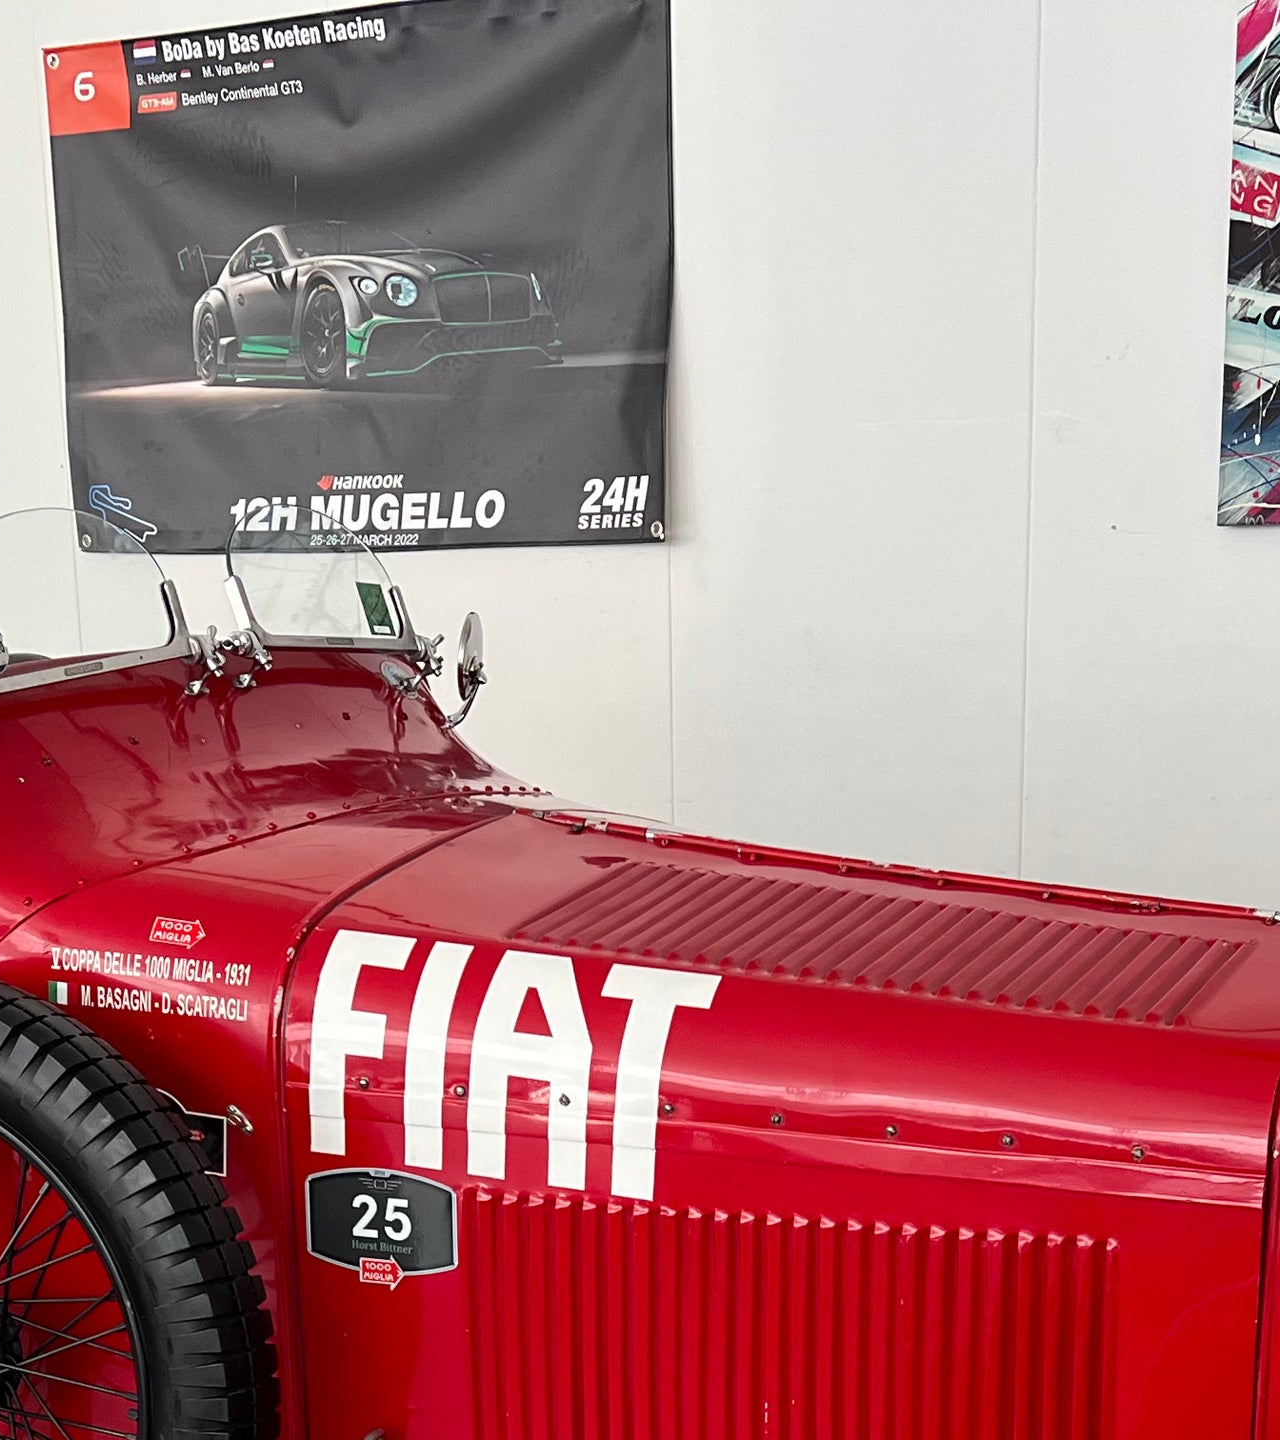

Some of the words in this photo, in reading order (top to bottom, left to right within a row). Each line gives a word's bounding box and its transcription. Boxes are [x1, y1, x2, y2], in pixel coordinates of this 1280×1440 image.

[161, 40, 203, 62] BoDa
[206, 38, 226, 61] by
[228, 30, 260, 53] Bas
[263, 24, 321, 49] Koeten
[323, 17, 386, 42] Racing
[73, 71, 96, 102] 6
[136, 74, 146, 86] B.
[148, 70, 177, 85] Herber
[202, 66, 213, 78] M.
[215, 64, 233, 77] Van
[235, 61, 260, 75] Berlo
[181, 90, 219, 108] Bentley
[220, 83, 278, 103] Continental
[280, 80, 303, 96] GT3
[579, 475, 649, 513] 24H
[229, 495, 297, 531] 12H
[310, 490, 506, 532] MUGELLO
[578, 512, 644, 530] SERIES
[310, 534, 352, 546] 25-26-27
[353, 533, 393, 546] MARCH
[394, 533, 419, 546] 2022
[153, 930, 192, 944] MIGLIA
[160, 920, 193, 933] 1000
[51, 947, 62, 970] V
[62, 948, 101, 974] COPPA
[103, 952, 142, 977] DELLE
[145, 955, 171, 979] 1000
[172, 958, 214, 983] MIGLIA
[224, 963, 251, 986] 1931
[81, 984, 94, 1008] M.
[97, 986, 152, 1013] BASAGNI
[161, 992, 174, 1015] D.
[177, 993, 248, 1021] SCATRAGLI
[309, 929, 722, 1201] FIAT
[352, 1194, 412, 1241] 25
[352, 1239, 377, 1251] Horst
[380, 1242, 413, 1254] Bittner
[363, 1271, 394, 1282] MIGLIA
[365, 1262, 392, 1272] 1000
